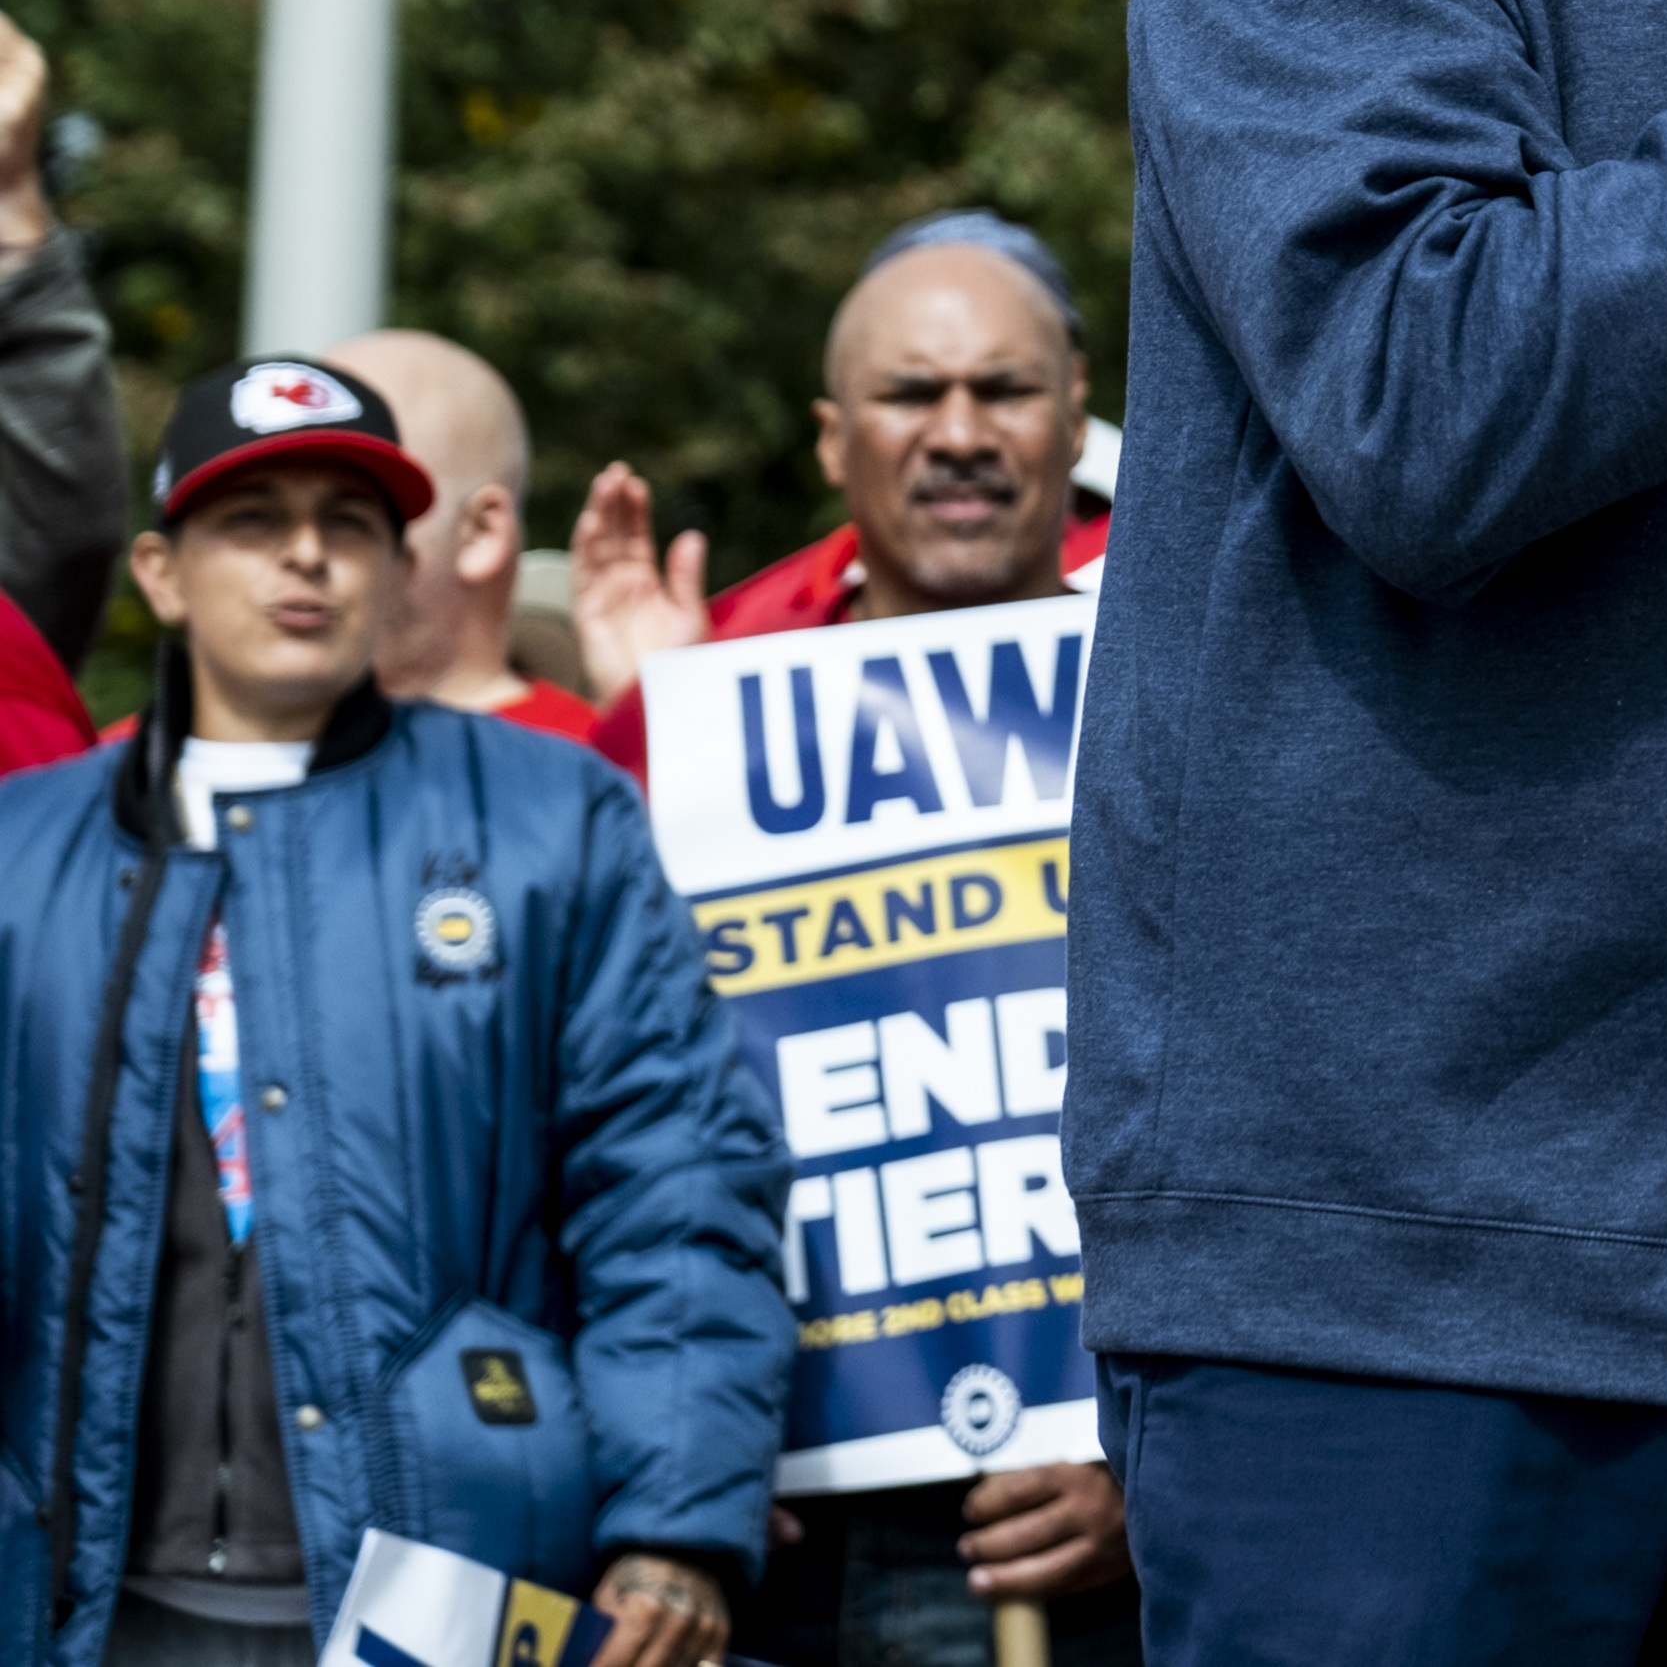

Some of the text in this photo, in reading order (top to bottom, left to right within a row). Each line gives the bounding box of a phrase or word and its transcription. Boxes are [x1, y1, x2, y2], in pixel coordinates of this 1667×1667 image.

[738, 634, 1083, 835] UAW
[706, 871, 1005, 977] STAND
[783, 1134, 1081, 1304] IER
[799, 1308, 878, 1350] ORE
[946, 1279, 1048, 1324] CLASS
